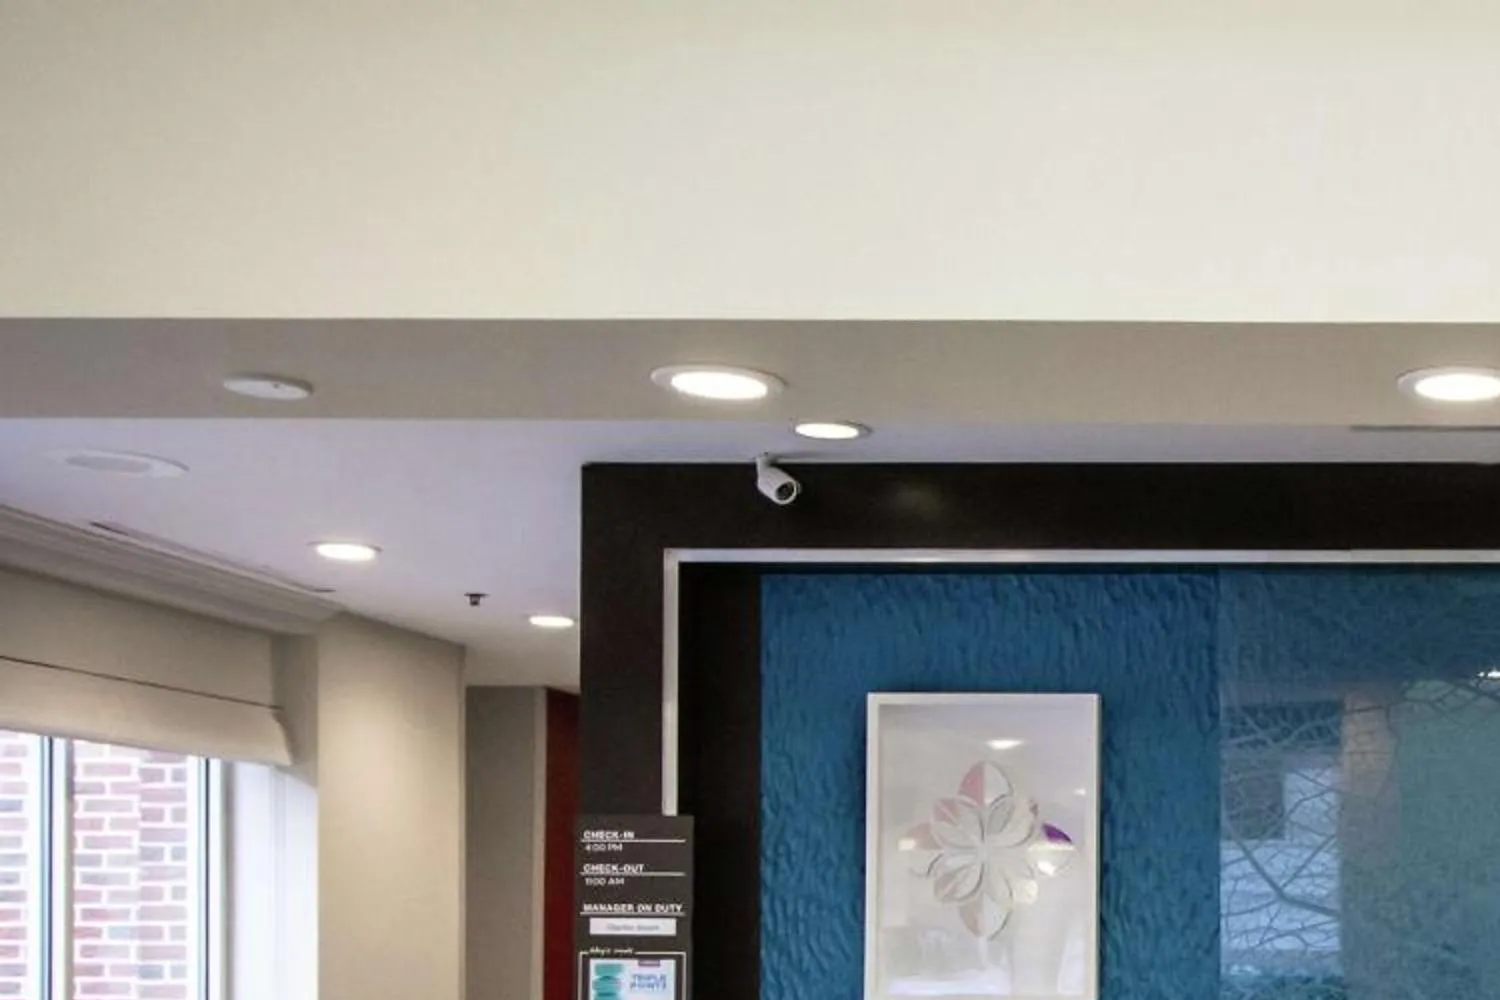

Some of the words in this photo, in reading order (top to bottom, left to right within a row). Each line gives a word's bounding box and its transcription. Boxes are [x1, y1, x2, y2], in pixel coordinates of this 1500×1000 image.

[583, 830, 635, 839] CHECK-IN
[607, 843, 623, 852] PM
[583, 863, 644, 874] CHECK-OUT
[607, 877, 625, 886] AM
[583, 903, 634, 913] MANAGER
[637, 903, 652, 913] ON
[655, 903, 683, 913] DUTY
